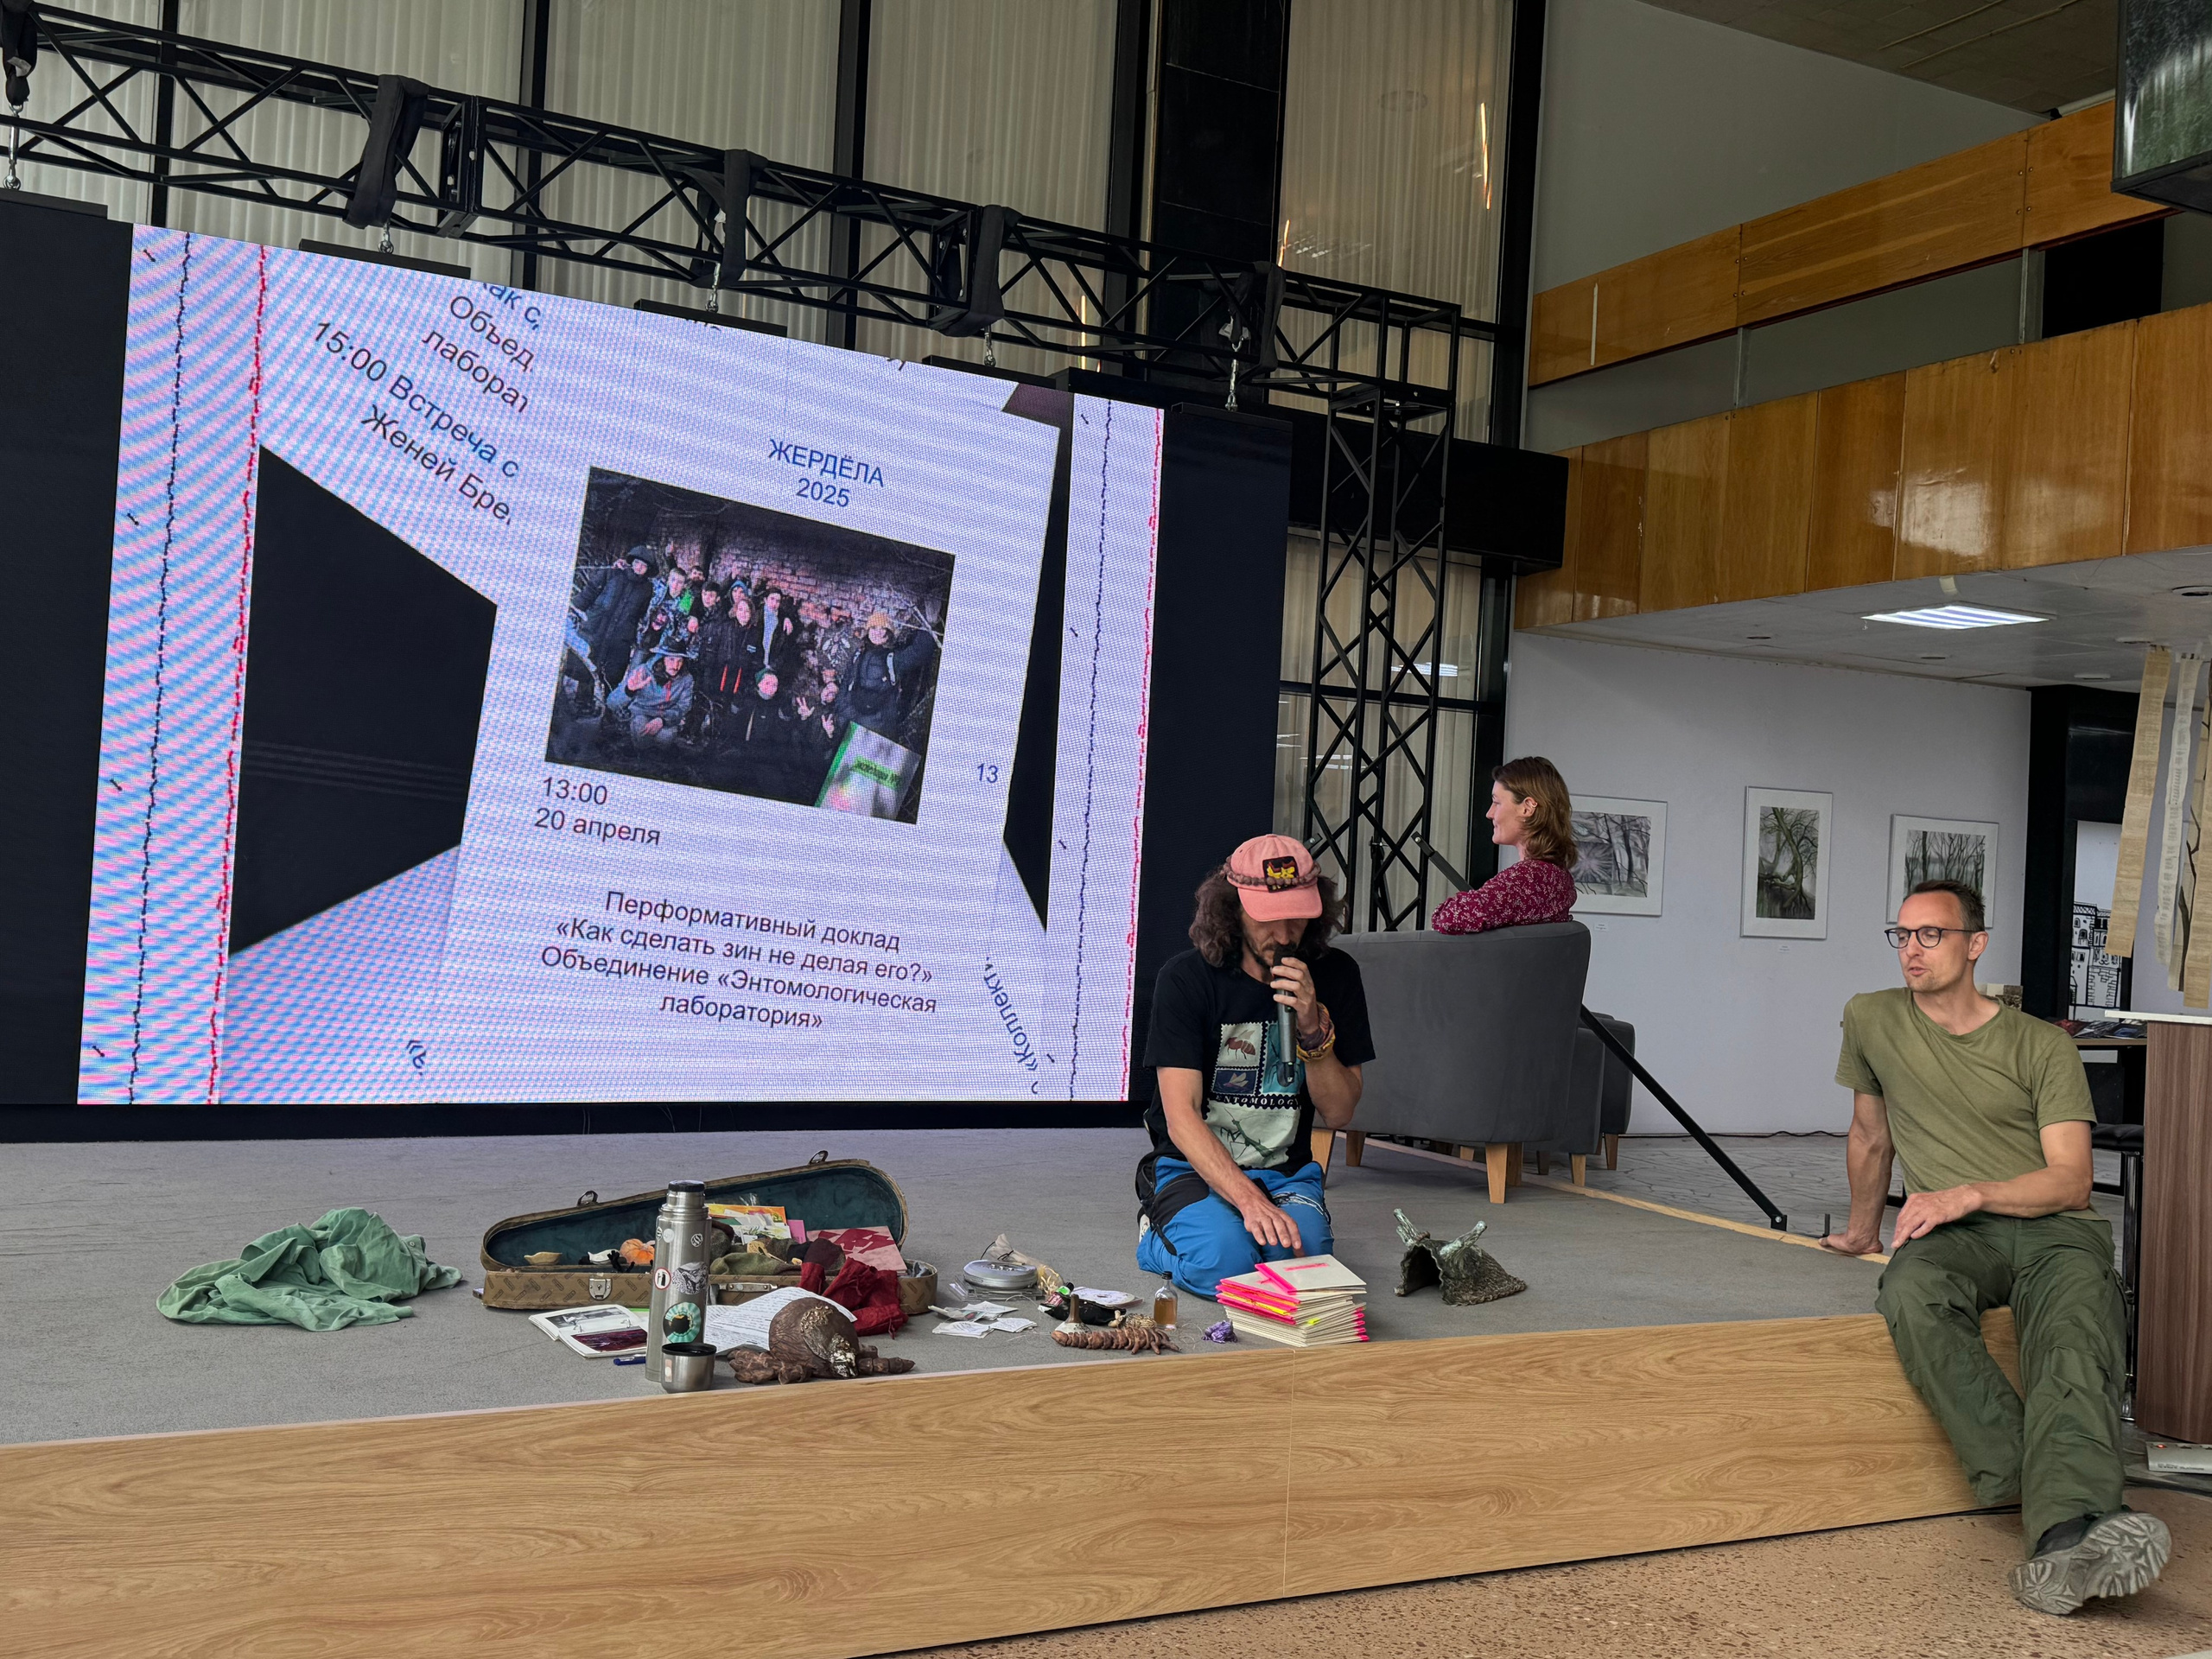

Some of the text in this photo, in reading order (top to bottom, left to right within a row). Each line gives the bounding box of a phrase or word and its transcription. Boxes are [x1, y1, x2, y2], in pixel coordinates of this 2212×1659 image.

[483, 283, 522, 310] ак
[315, 322, 518, 478] 15:00 Встреча с
[361, 404, 512, 525] Женей Бре
[768, 438, 884, 487] ЖЕРДЁЛА
[797, 478, 849, 507] 2025
[543, 777, 608, 805] 13:00
[976, 763, 999, 784] 13
[535, 807, 661, 846] 20 апреля
[606, 891, 900, 953] Перформативный доклад
[556, 918, 932, 982] «Как сделать зин не делая его?»
[542, 946, 937, 1014] Объединение «Энтомологическая
[659, 995, 823, 1028] лаборатория»
[1215, 1094, 1299, 1106] ENTOMOLOG
